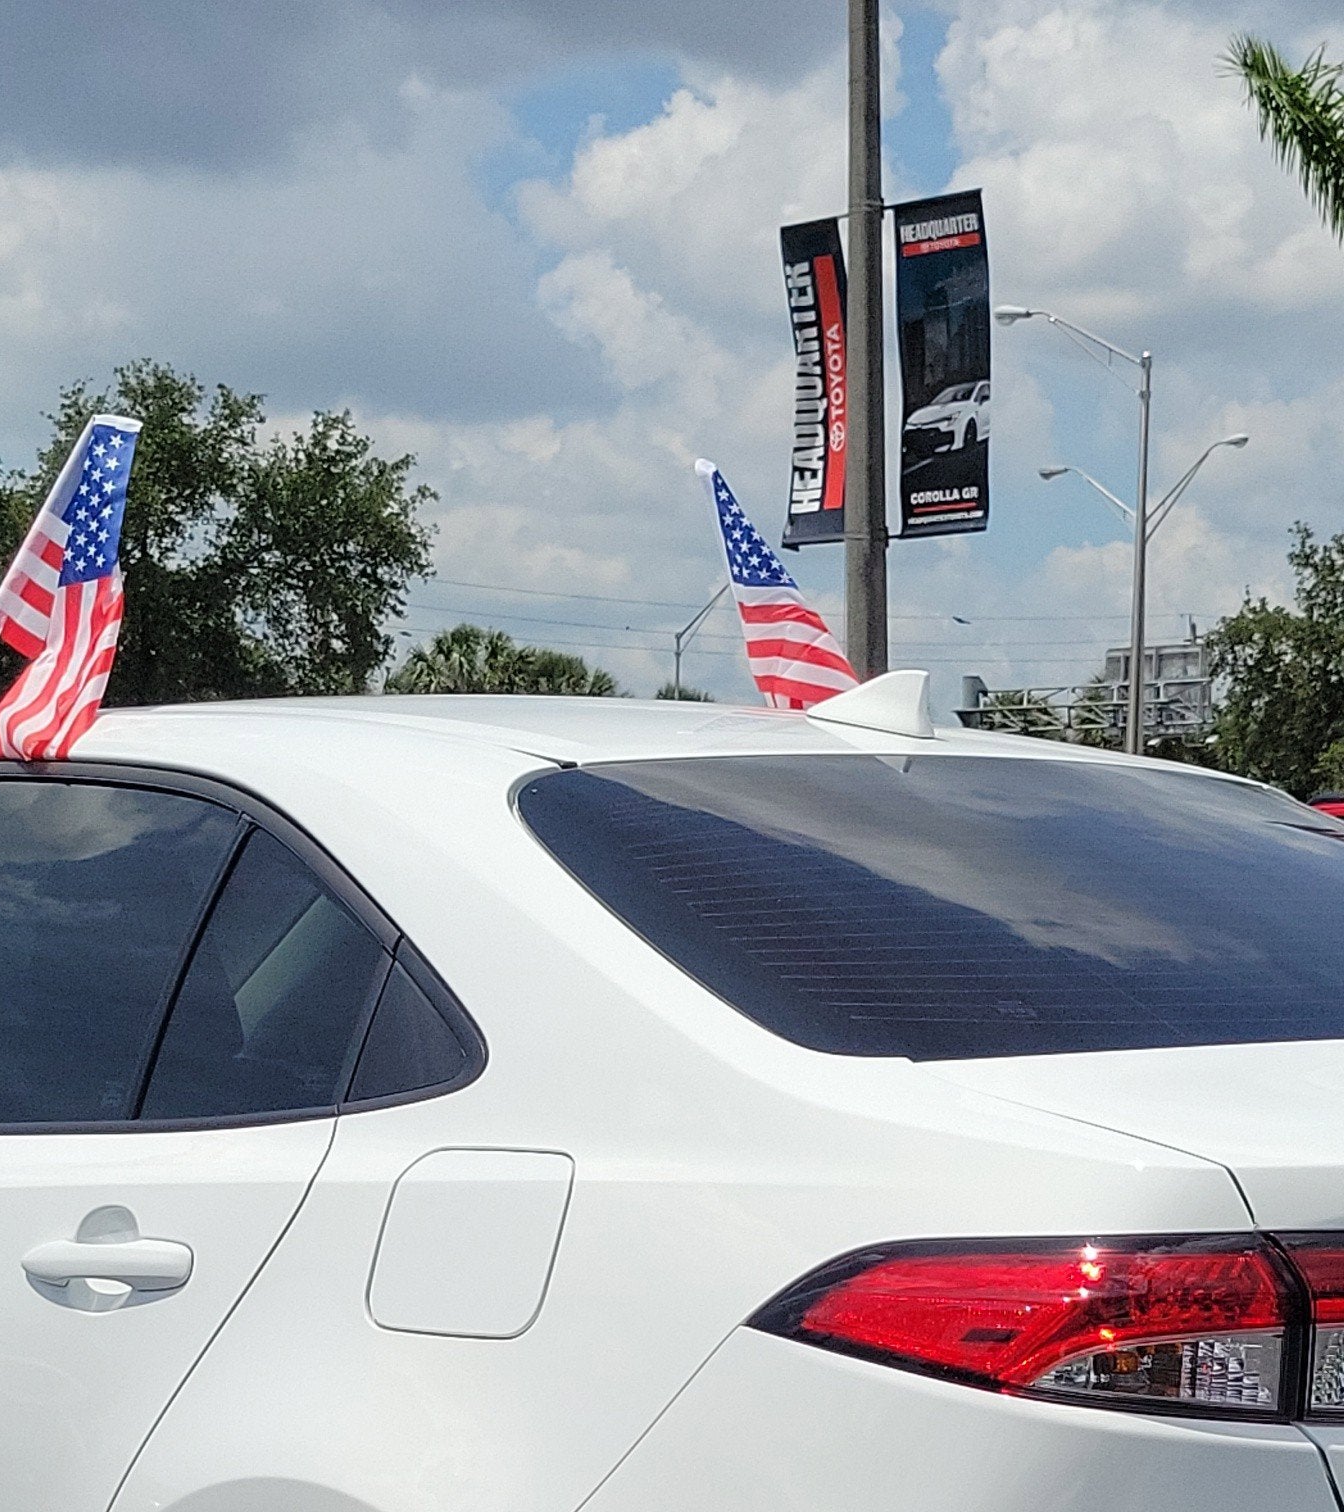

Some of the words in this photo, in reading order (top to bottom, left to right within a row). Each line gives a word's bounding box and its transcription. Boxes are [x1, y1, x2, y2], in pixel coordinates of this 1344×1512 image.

[900, 213, 979, 244] HEADQUARTER
[786, 260, 827, 514] HEADQUARTER
[826, 323, 845, 417] TOYOTA
[910, 488, 960, 505] COROLLA
[962, 486, 979, 499] GR
